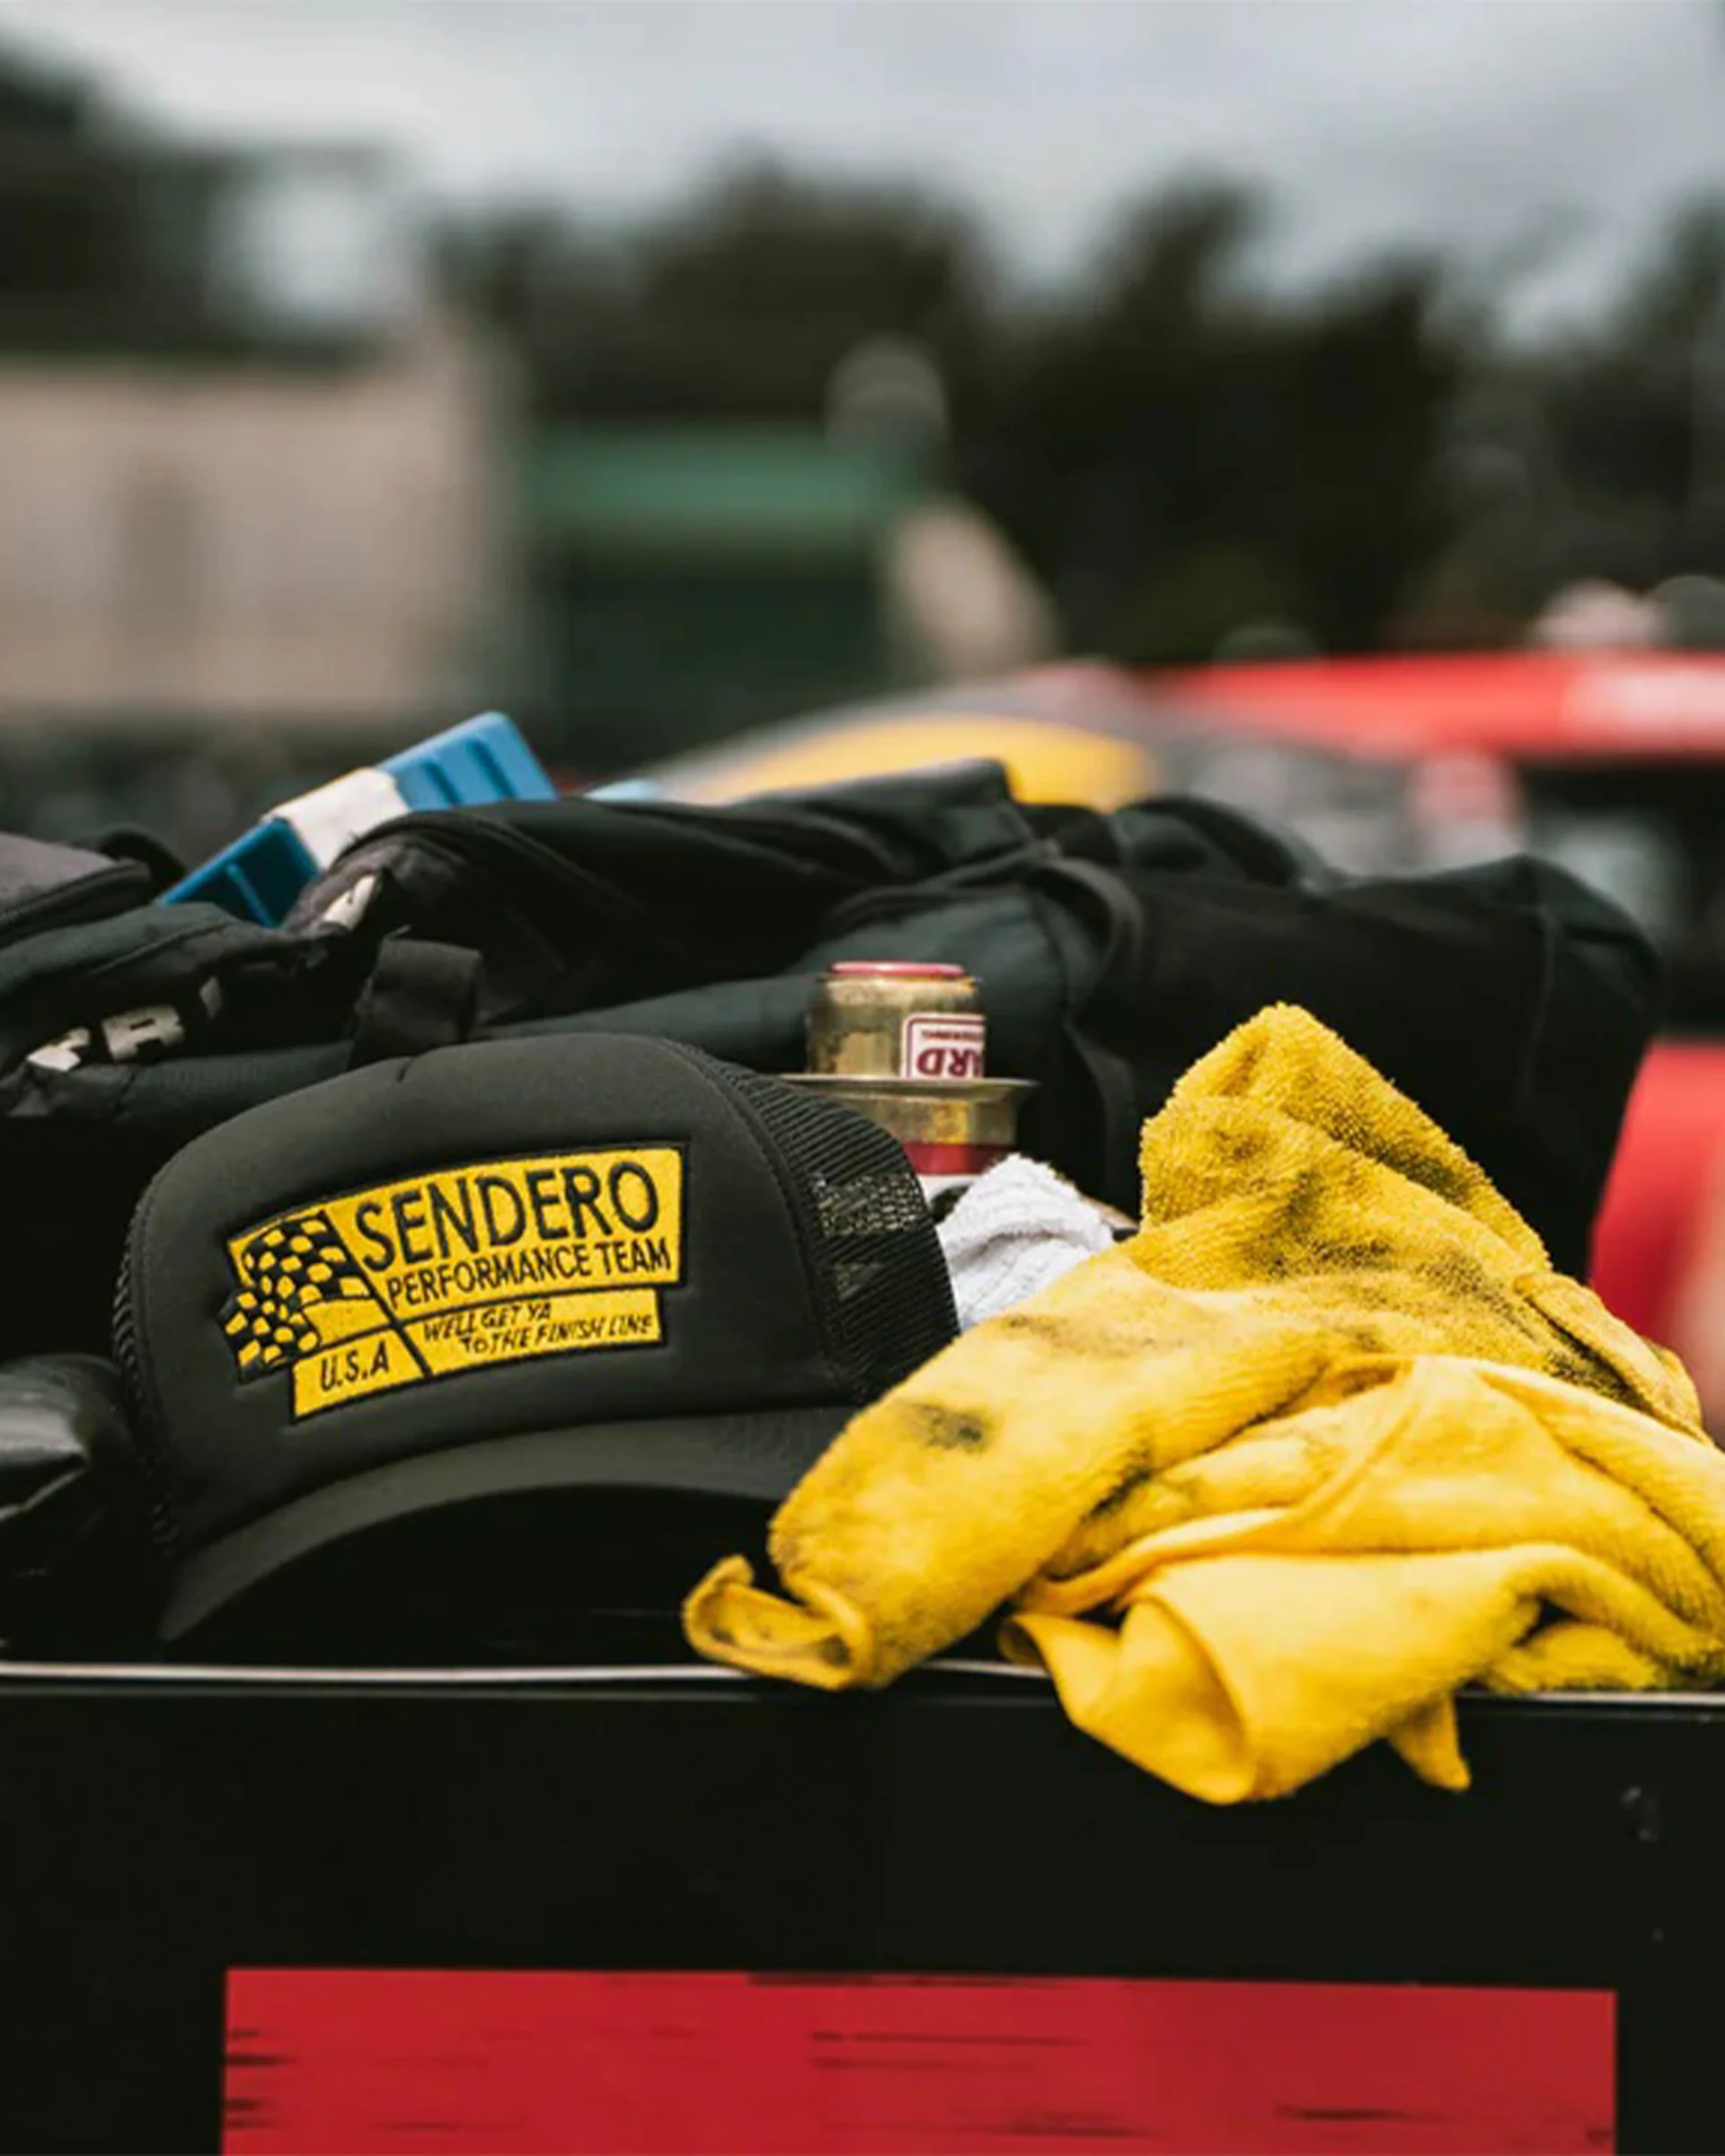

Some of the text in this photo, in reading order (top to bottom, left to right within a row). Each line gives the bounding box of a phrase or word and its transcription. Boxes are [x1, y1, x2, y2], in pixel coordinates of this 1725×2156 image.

[355, 1161, 659, 1272] SENDERO
[385, 1237, 672, 1310] PERFORMANCE TEAM
[460, 1313, 653, 1355] TO THE FINISH LINE
[481, 1305, 522, 1329] GET
[527, 1302, 553, 1321] YA
[320, 1342, 390, 1392] U.S.A
